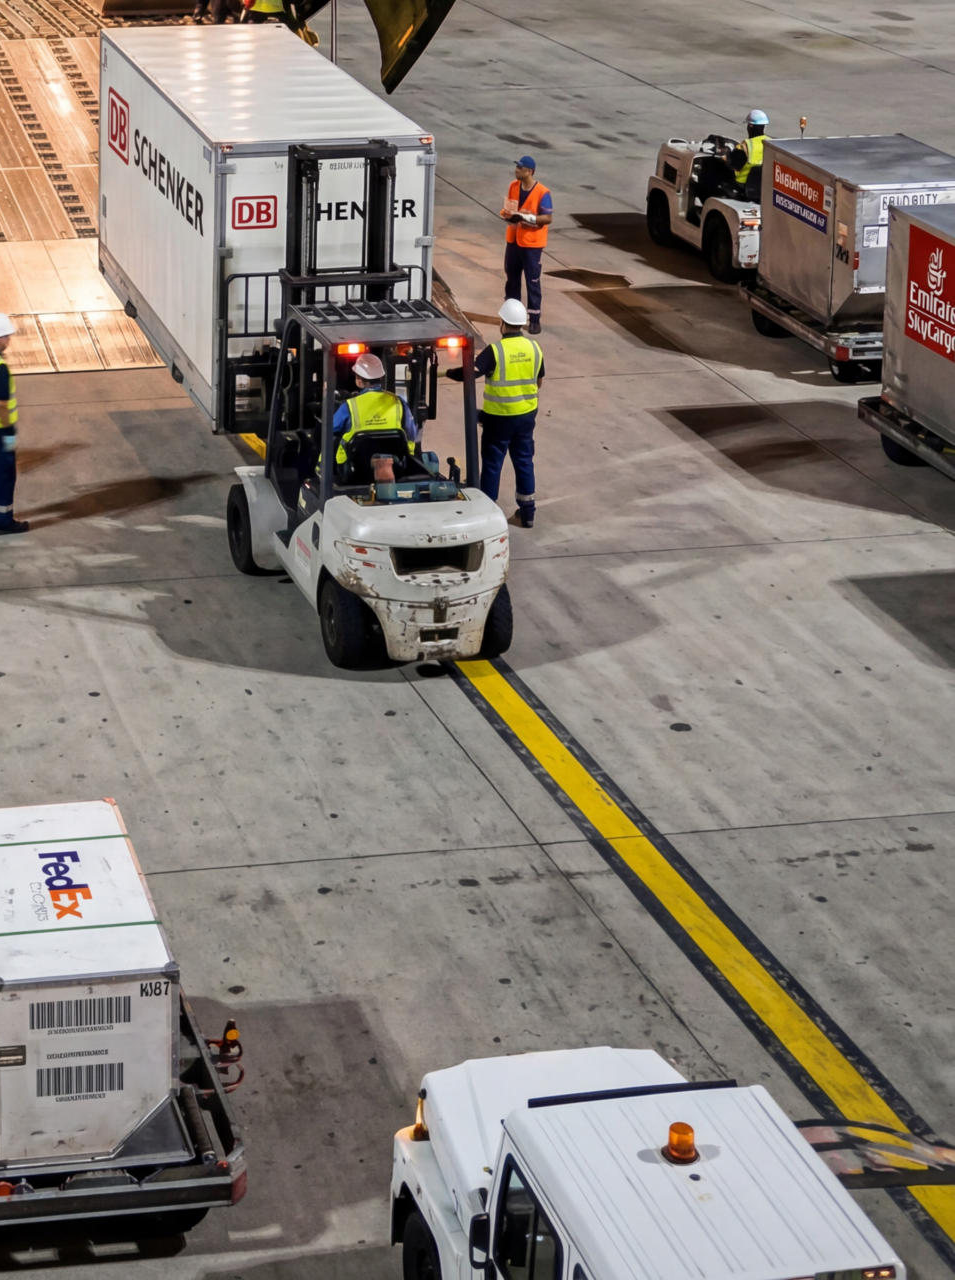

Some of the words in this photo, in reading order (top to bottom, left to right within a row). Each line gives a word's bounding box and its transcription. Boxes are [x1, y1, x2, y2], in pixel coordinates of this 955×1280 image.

[110, 97, 128, 152] DB
[134, 128, 204, 237] SCHENKER
[237, 201, 272, 224] DB
[38, 851, 93, 921] FedEx
